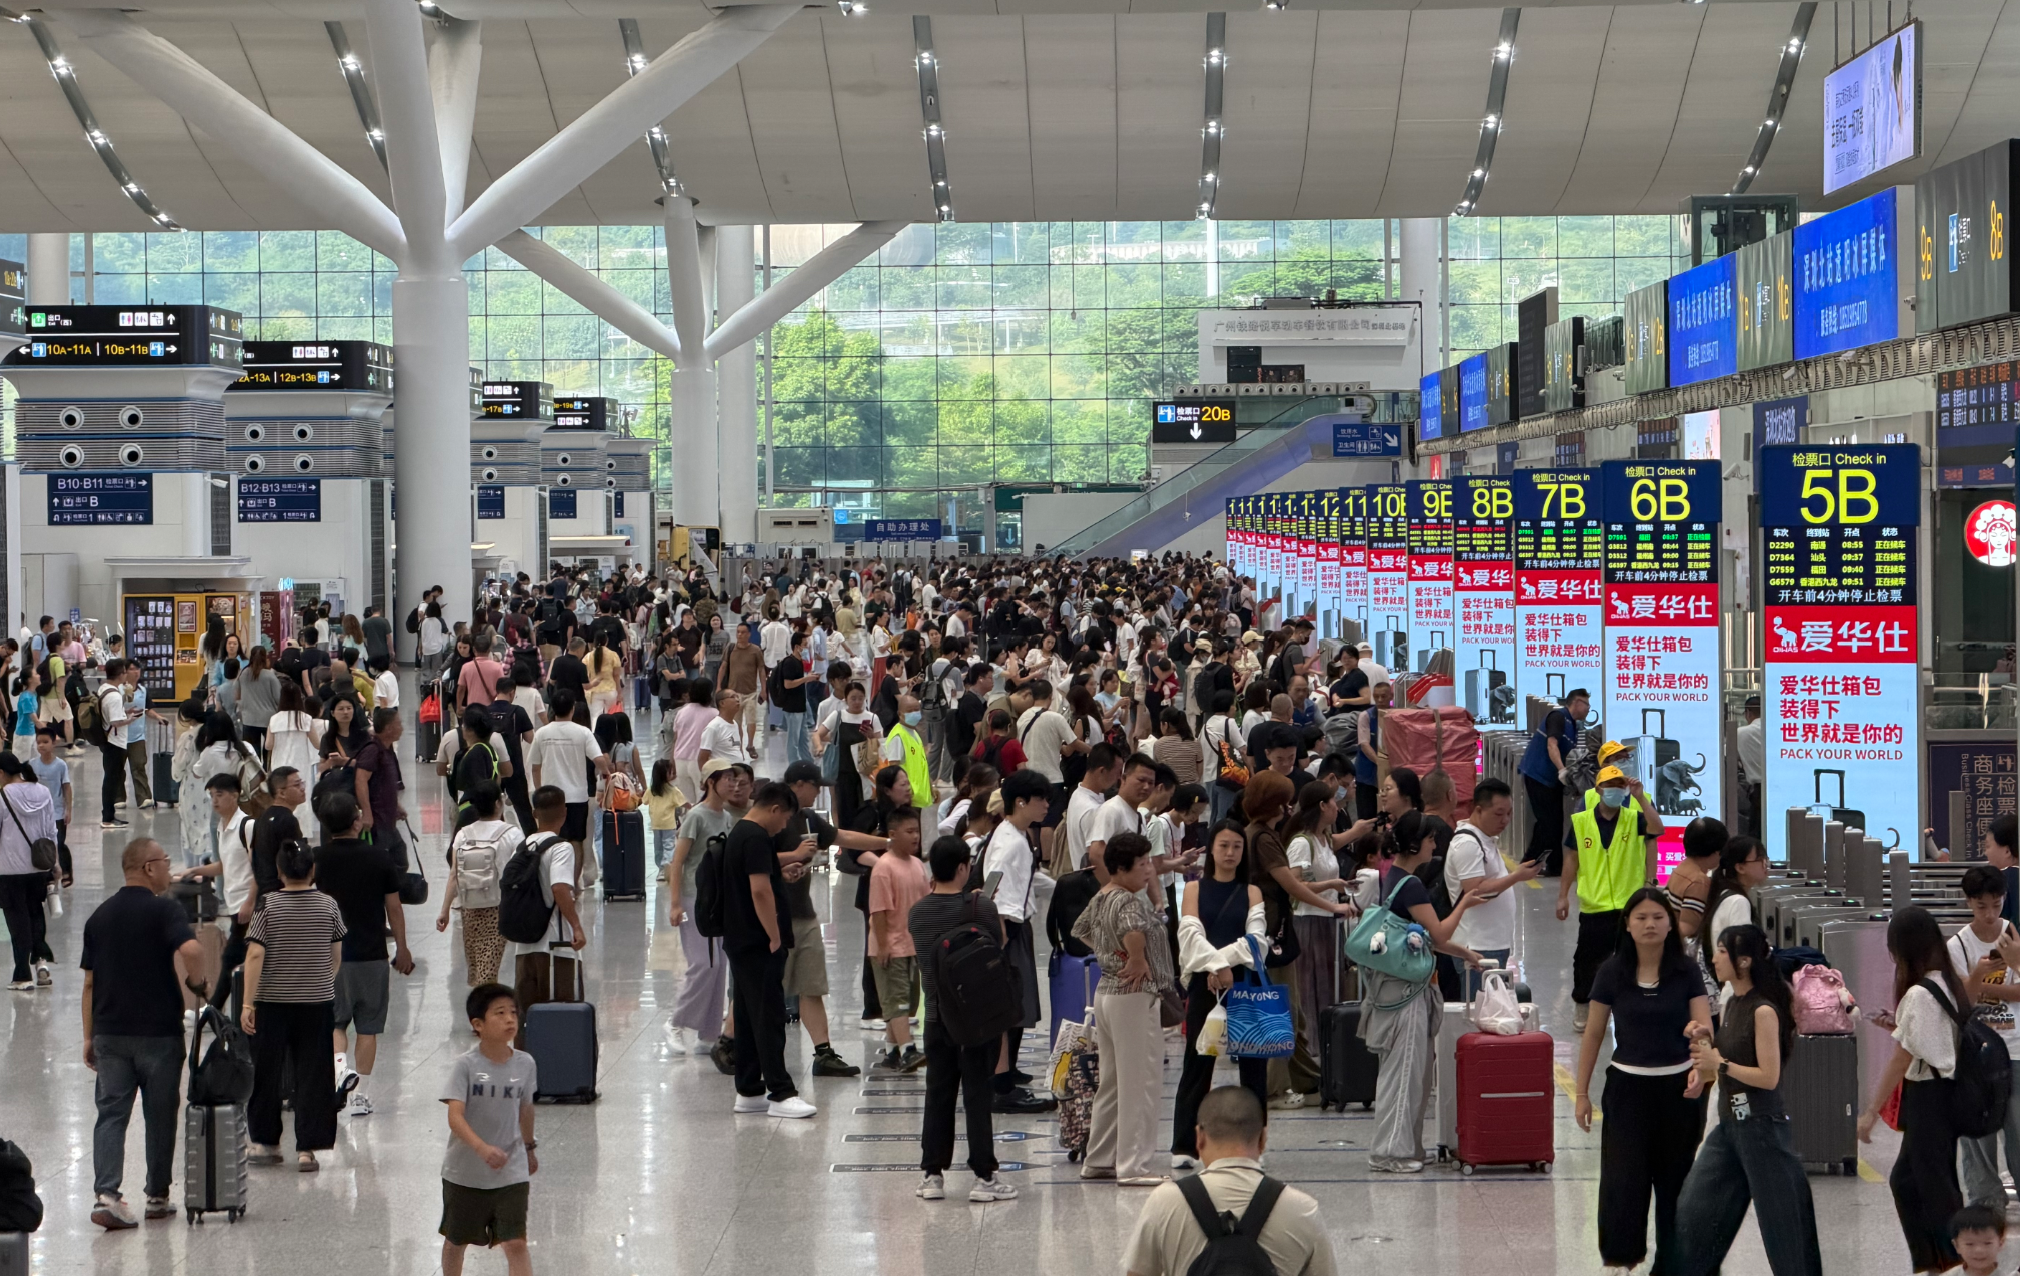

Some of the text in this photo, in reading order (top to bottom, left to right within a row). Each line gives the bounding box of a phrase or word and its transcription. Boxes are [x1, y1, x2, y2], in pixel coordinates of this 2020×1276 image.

[1990, 200, 2003, 261] 8B
[1921, 225, 1933, 281] 9B
[47, 344, 148, 355] 10A-11A 10B-11B
[237, 373, 316, 382] 2A-13A 12B-13B
[1177, 406, 1231, 421] 检票口 20B
[1792, 453, 1887, 467] 检票口 Check in
[1532, 473, 1556, 482] 检票口
[1583, 473, 1590, 481] in
[1625, 466, 1696, 477] 检票口 Check in
[90, 496, 98, 507] B
[269, 498, 276, 507] B
[1472, 488, 1513, 518] 8B
[1537, 484, 1586, 519] 7B
[1630, 479, 1691, 521] 6B
[1800, 469, 1879, 524] 5B
[876, 522, 930, 532] 自助办理处
[1773, 527, 1898, 537] 车次 终到站 开点 状态
[1769, 541, 1906, 550] D2290 南通 08:55 正在候车
[1524, 559, 1600, 568] 开车前4分钟停止检票
[1769, 553, 1906, 562] D7364 汕头 09:37 正在候车
[1615, 571, 1708, 581] 开车前4分钟停止检票
[1769, 565, 1906, 574] D7559 福田 09:40 正在候车
[1473, 569, 1513, 586] 爱华
[1769, 578, 1906, 587] G6579 香港西九龙 09:51 正在候车
[1538, 579, 1601, 600] 爱华仕
[1778, 589, 1903, 603] 开车前4分钟停止检票
[1415, 598, 1442, 608] 装得下
[1462, 598, 1514, 609] 爱华仕箱包
[1632, 595, 1713, 619] 爱华仕
[1462, 611, 1493, 622] 装得下
[1525, 613, 1587, 627] 爱华仕箱包
[1525, 628, 1562, 642] 装得下
[1801, 621, 1908, 653] 爱华仕
[1525, 644, 1600, 658] 世界就是你的
[1616, 636, 1692, 653] 爱华仕箱包
[1525, 660, 1601, 668] PACK YOUR WORLD
[1616, 655, 1661, 671] 装得下
[1616, 673, 1709, 689] 世界就是你的
[1780, 675, 1882, 696] 爱华仕箱包
[1616, 693, 1708, 702] PACK YOUR WORLD
[1780, 699, 1840, 720] 装得下
[1780, 722, 1903, 744] 世界就是你的
[1780, 749, 1903, 760] PACK YOUR WORLD
[1997, 776, 2016, 815] 检票
[1966, 850, 1972, 858] in
[1233, 990, 1279, 1001] MAYONG
